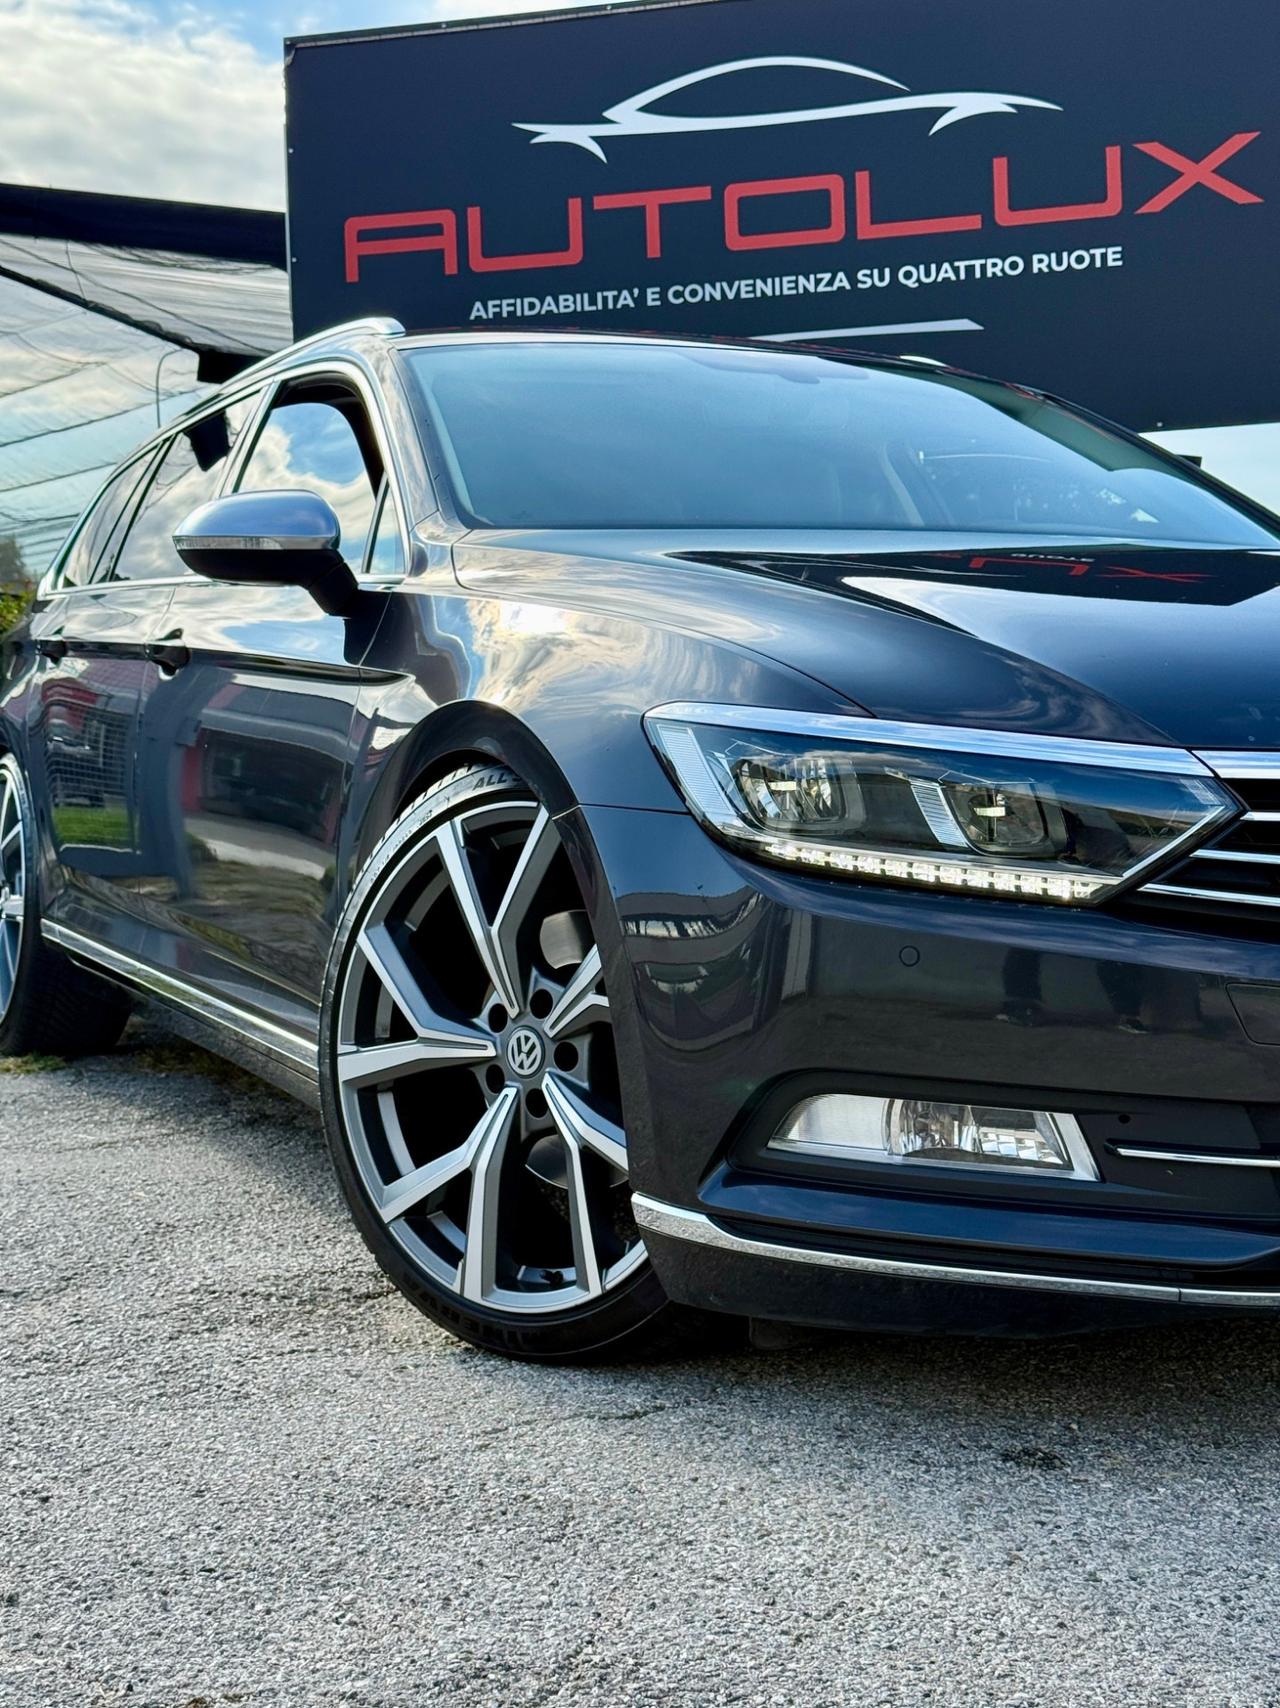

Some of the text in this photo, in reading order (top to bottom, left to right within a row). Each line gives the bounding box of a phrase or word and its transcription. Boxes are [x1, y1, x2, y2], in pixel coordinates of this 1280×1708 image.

[344, 131, 1263, 283] AUTOLUX
[646, 287, 661, 307] E
[667, 271, 850, 304] CONVENIENZA
[857, 267, 890, 289] SU
[897, 255, 1024, 288] QUATTRO
[1032, 246, 1123, 274] RUOTE
[472, 772, 508, 791] ALL
[507, 1029, 542, 1076] VW
